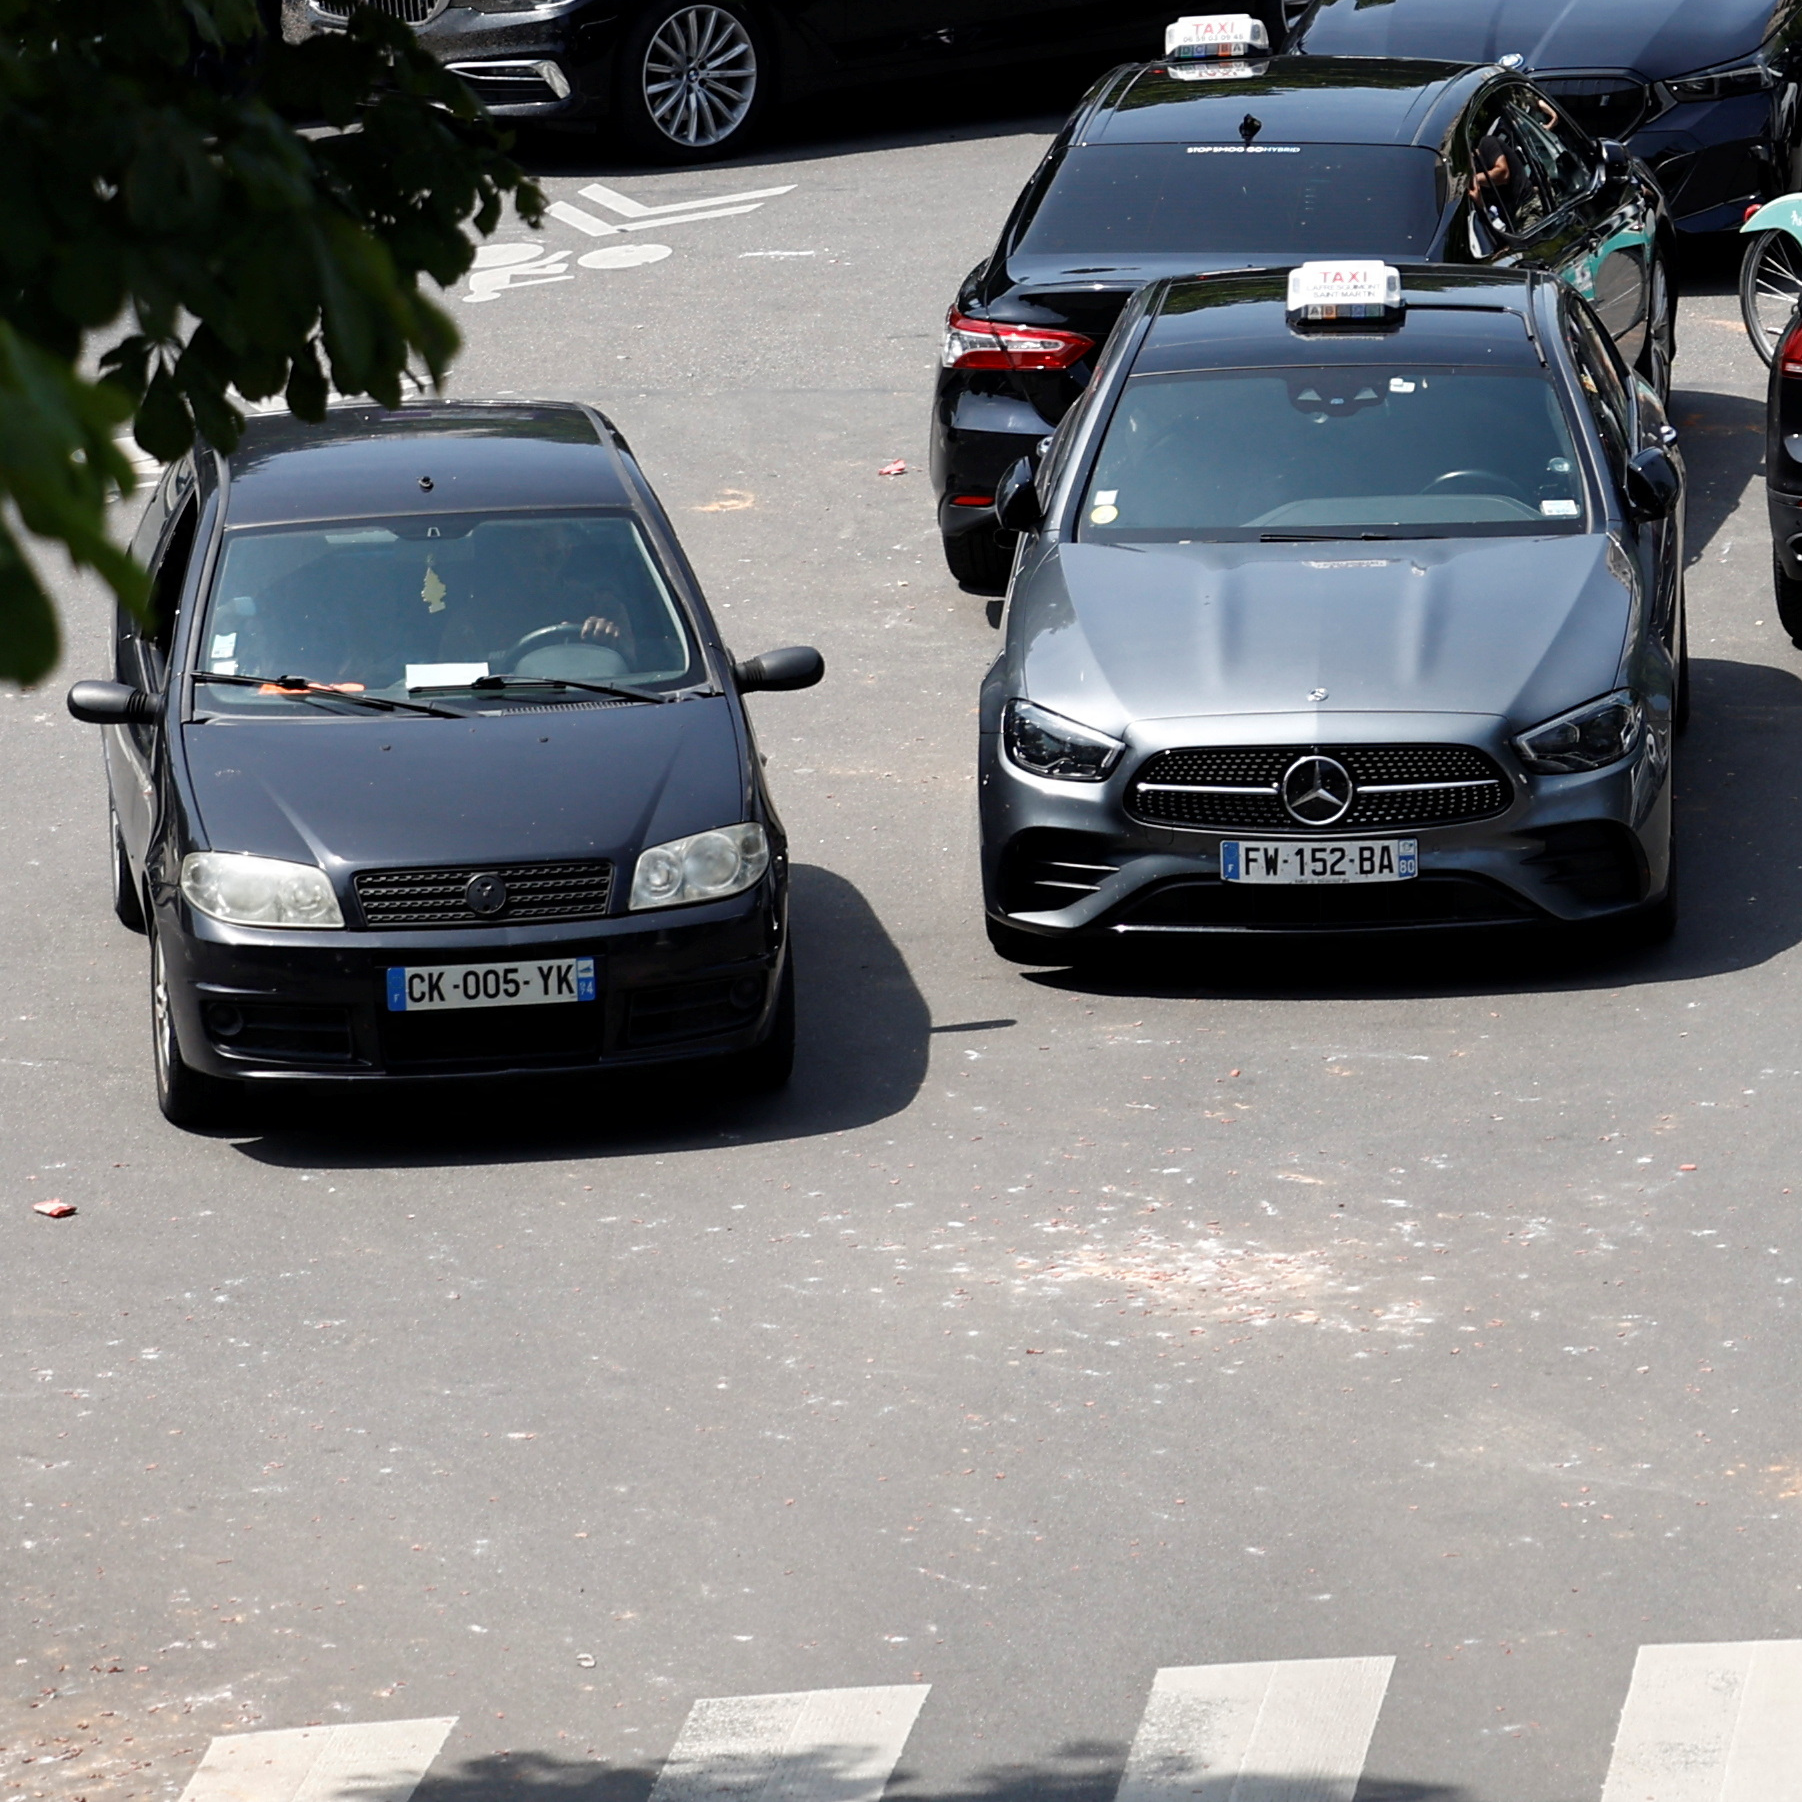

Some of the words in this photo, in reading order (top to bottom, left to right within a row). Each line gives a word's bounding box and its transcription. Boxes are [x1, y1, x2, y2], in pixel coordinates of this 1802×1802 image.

[1191, 22, 1234, 35] TAXI
[1319, 270, 1368, 283] TAXI
[1313, 291, 1339, 299] SAINT
[1341, 290, 1376, 298] MARTIN
[1244, 843, 1396, 878] FW-152-BA
[1400, 859, 1415, 874] 80
[406, 961, 577, 1004] CK-005-YK
